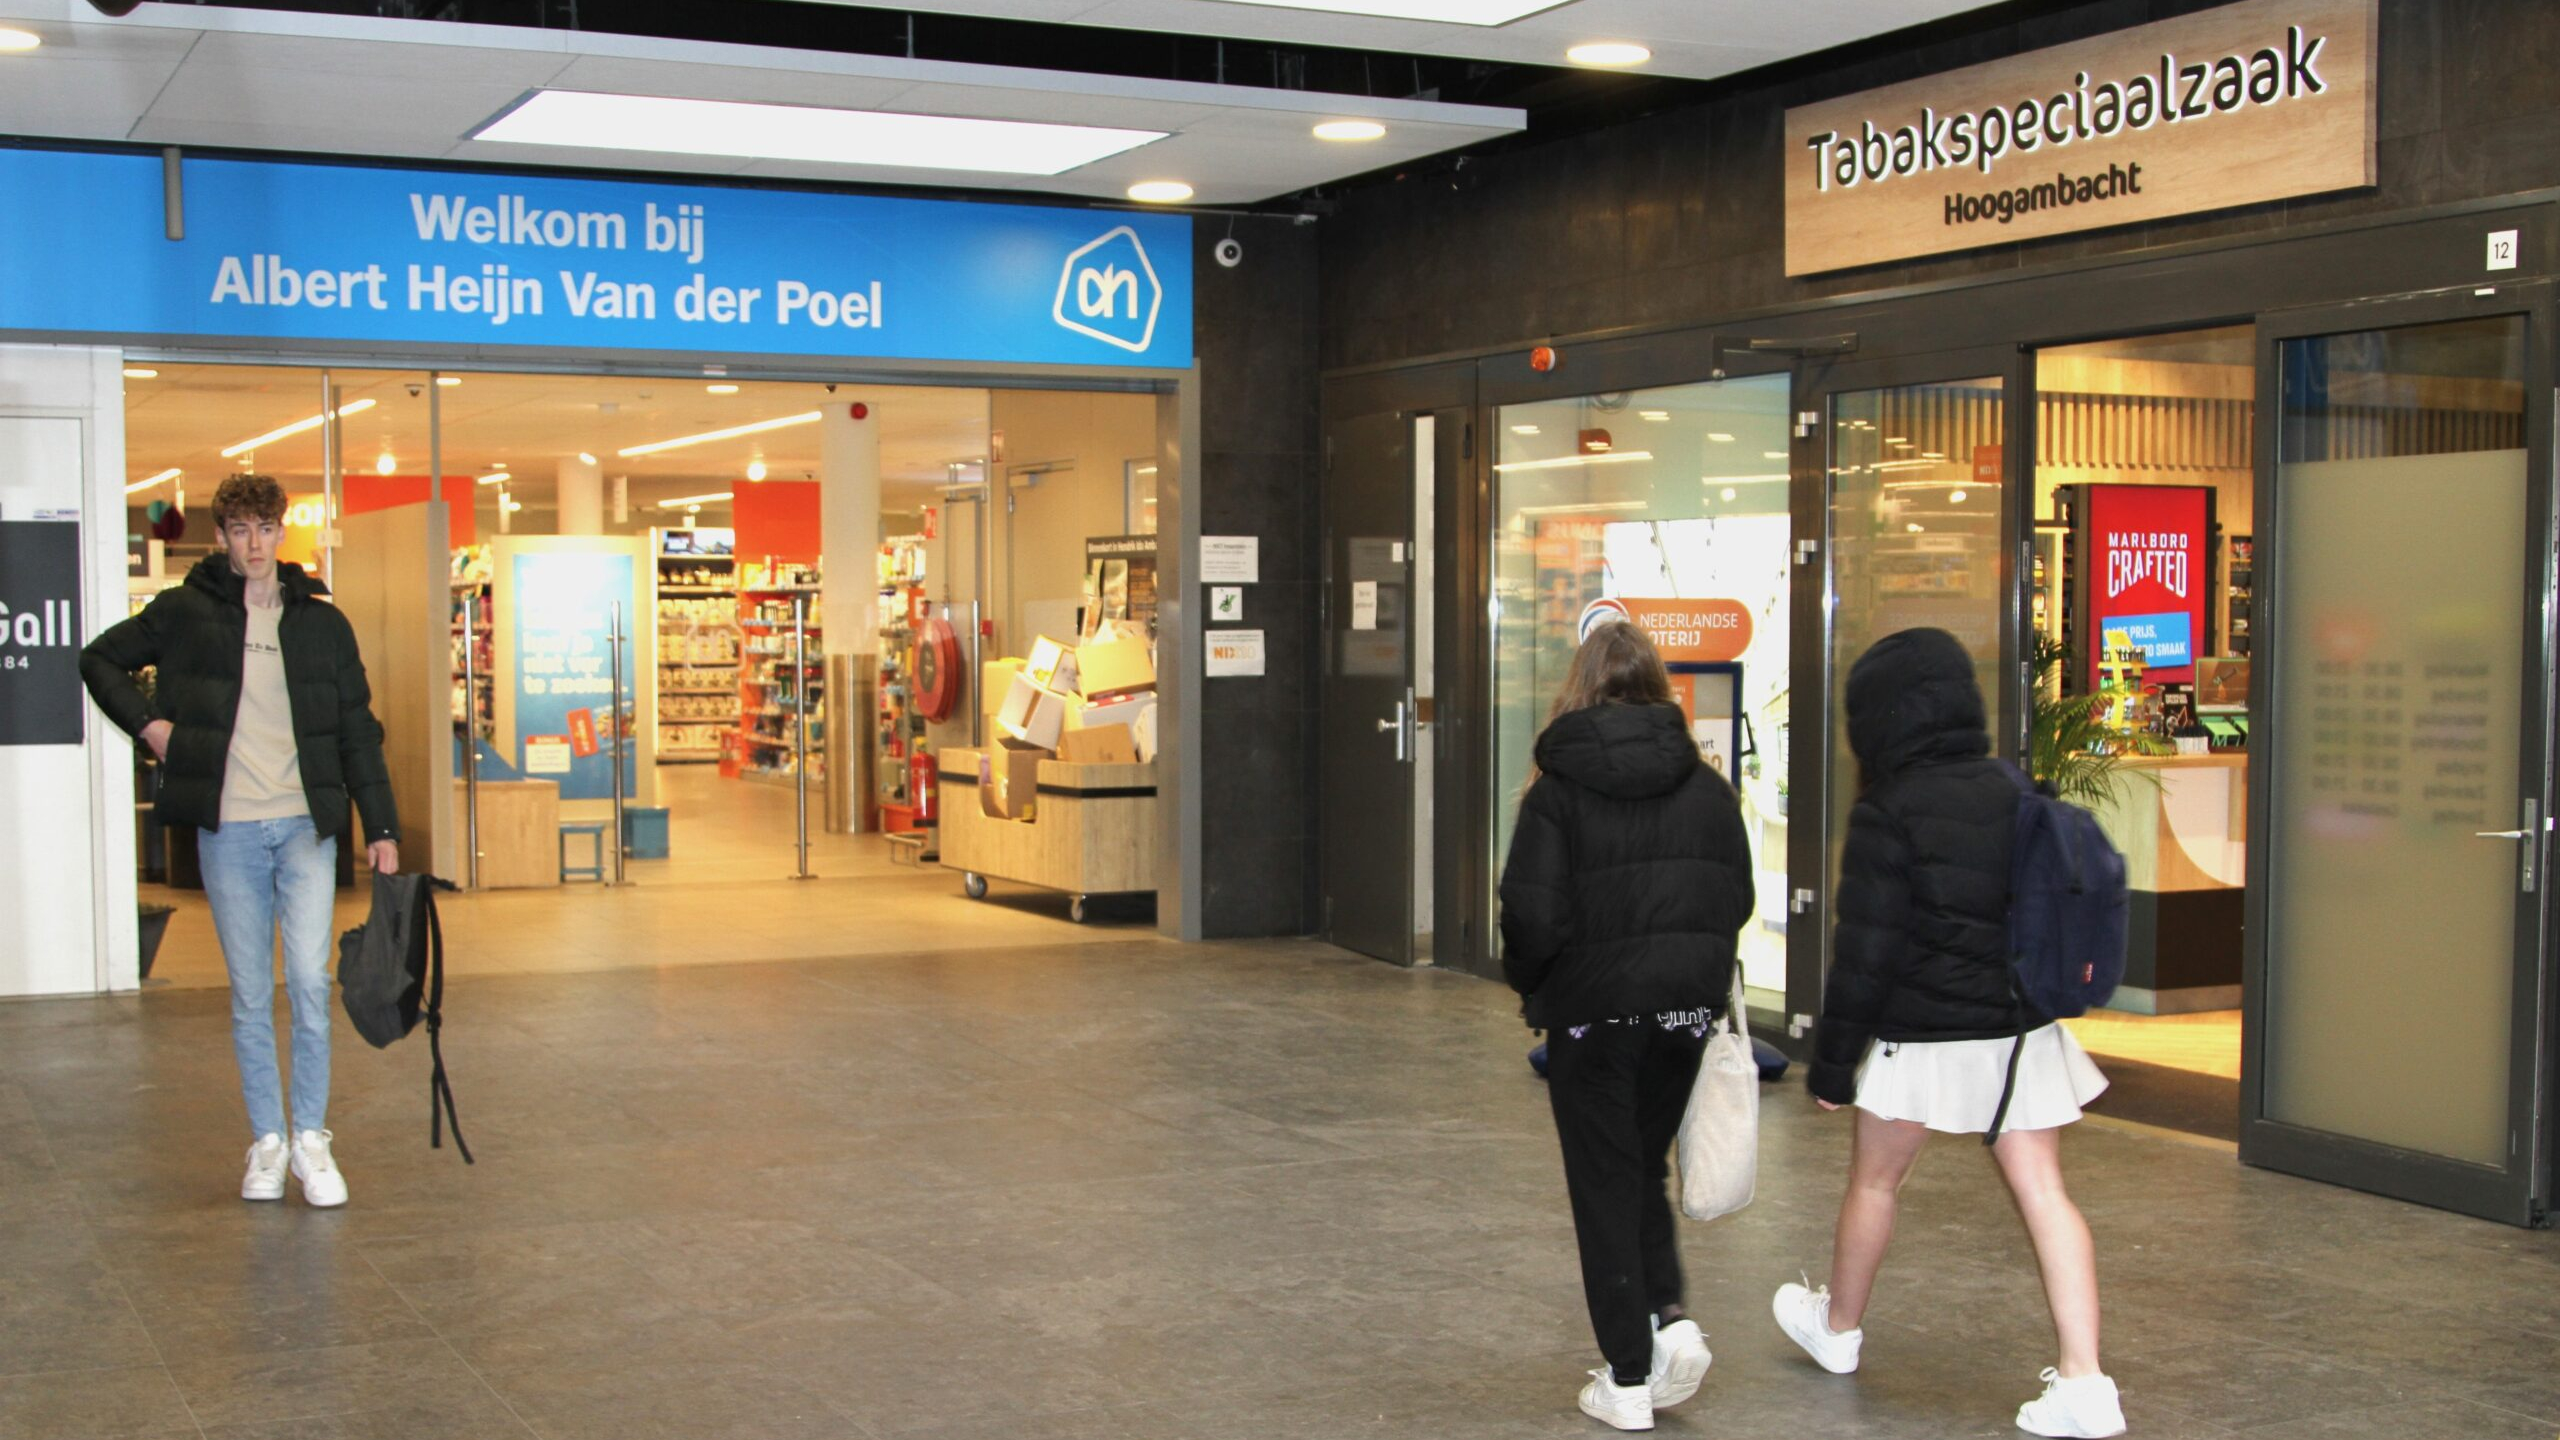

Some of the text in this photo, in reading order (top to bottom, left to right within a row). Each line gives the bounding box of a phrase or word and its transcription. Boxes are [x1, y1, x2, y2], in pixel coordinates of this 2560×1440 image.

[1808, 25, 2327, 192] Tabakspeciaalzaak
[1944, 161, 2141, 225] Hoogambacht
[410, 194, 704, 264] Welkom bij
[2493, 241, 2510, 260] 12
[211, 254, 882, 329] Albert Heijn Van der Poel
[2109, 532, 2188, 549] MARLBORO
[2108, 550, 2188, 598] CRAFTED
[1640, 613, 1739, 629] NEDERLANDSE
[1647, 630, 1701, 647] OTERIJ
[2156, 641, 2186, 656] SMAAK
[0, 655, 30, 669] 84
